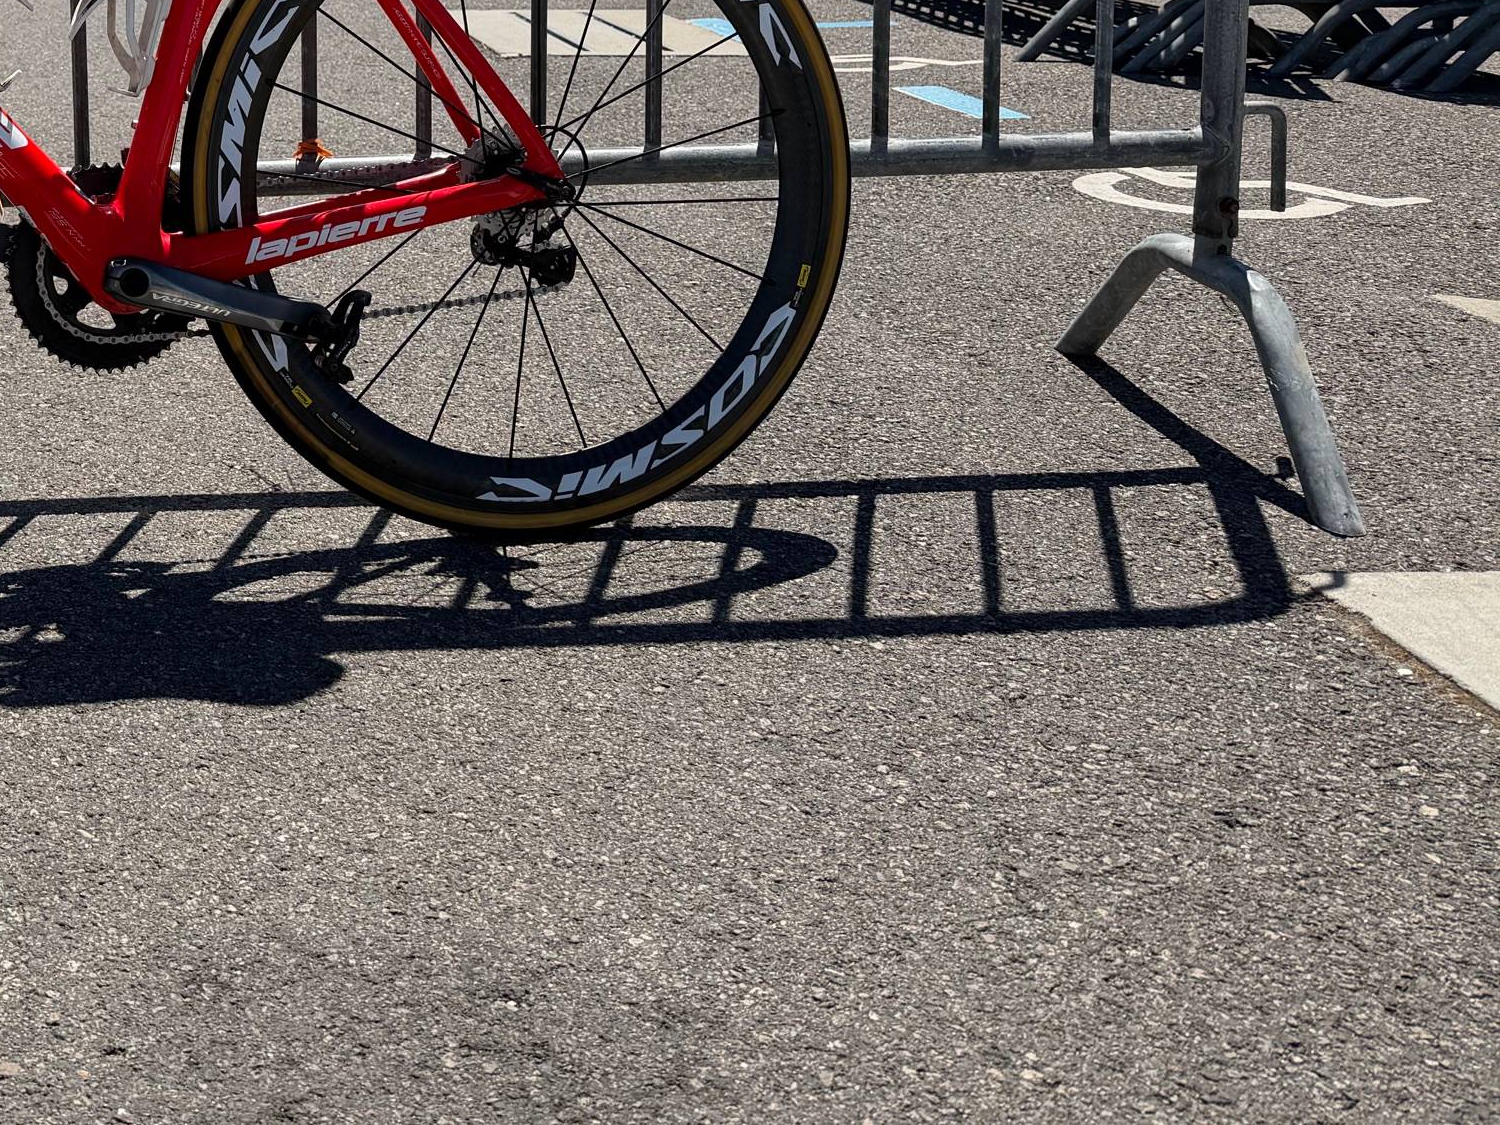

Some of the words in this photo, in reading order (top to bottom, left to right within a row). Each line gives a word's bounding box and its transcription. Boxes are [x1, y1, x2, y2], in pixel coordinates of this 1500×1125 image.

[245, 205, 427, 265] lapierre
[152, 291, 232, 319] ULTEGRA
[475, 301, 797, 502] COSMIC
